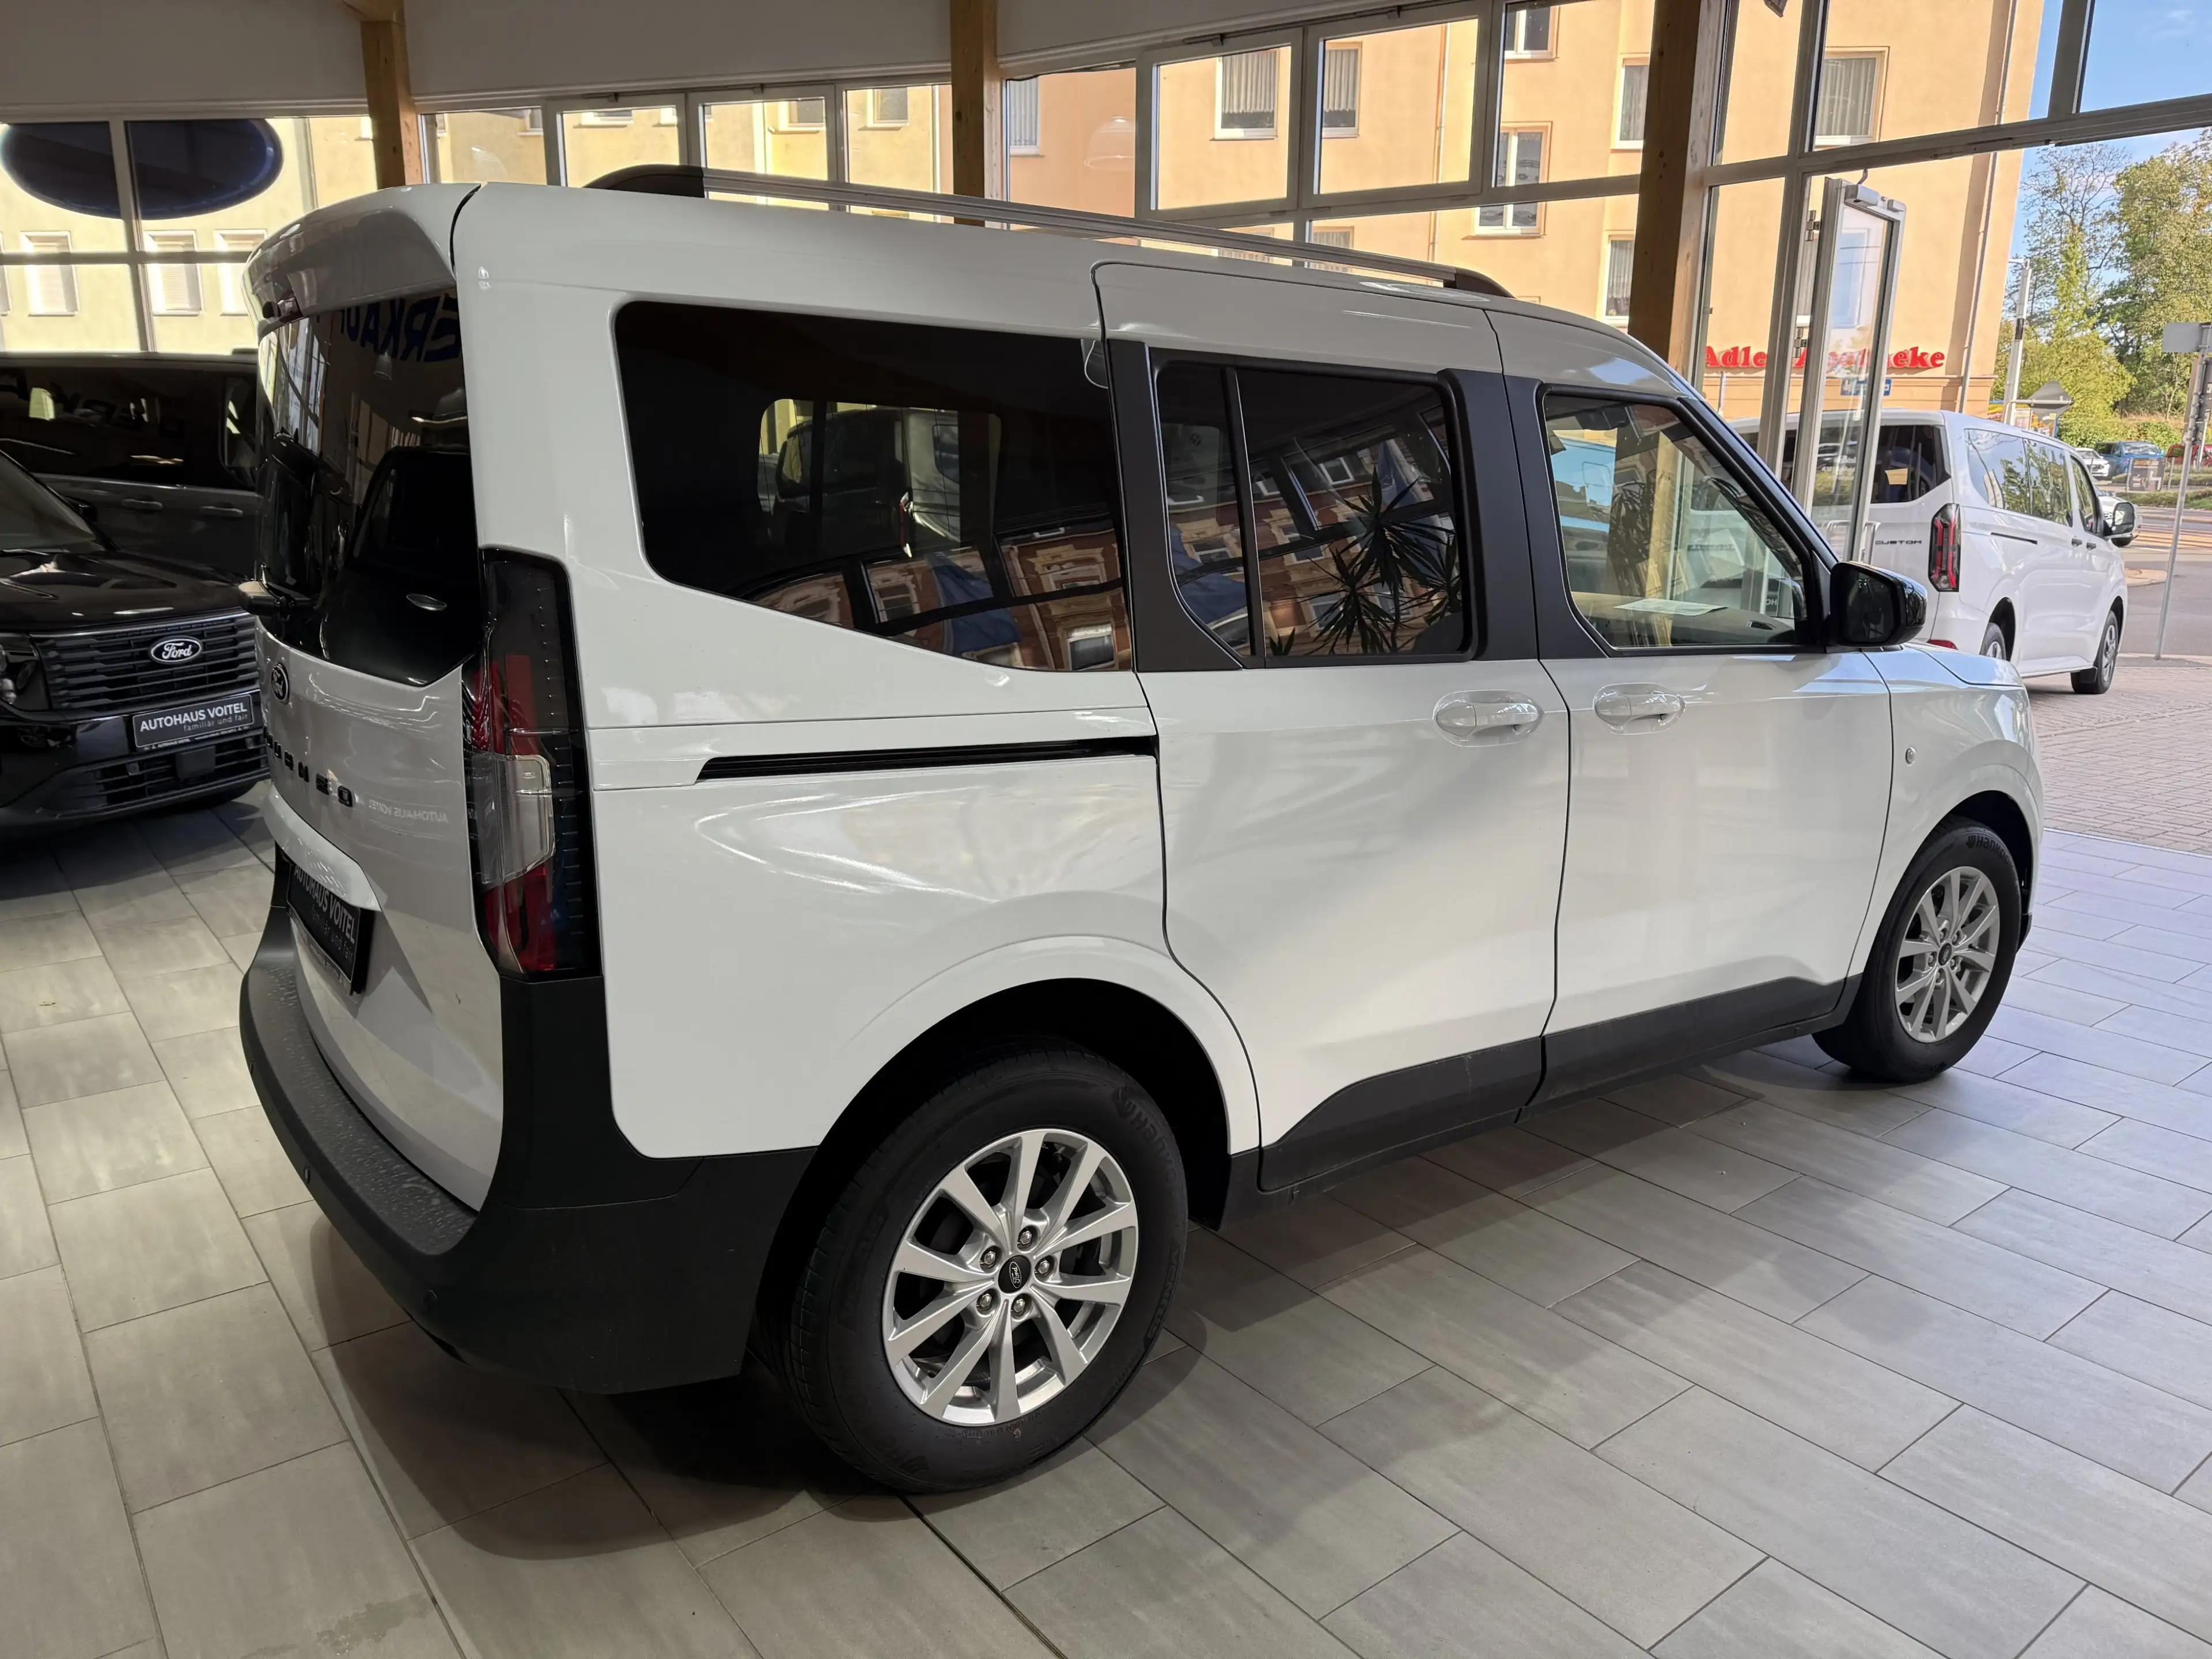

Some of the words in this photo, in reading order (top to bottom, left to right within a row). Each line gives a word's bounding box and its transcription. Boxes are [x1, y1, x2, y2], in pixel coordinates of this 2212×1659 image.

[1705, 346, 1767, 368] Adle
[162, 642, 192, 660] Ford
[272, 669, 285, 697] Ford
[140, 710, 206, 732] AUTOHAUS
[207, 702, 247, 718] VOITEL
[218, 716, 232, 725] und
[329, 895, 355, 945] VOITEL
[331, 929, 343, 950] und
[343, 940, 354, 964] fair
[1011, 1266, 1020, 1284] Ford
